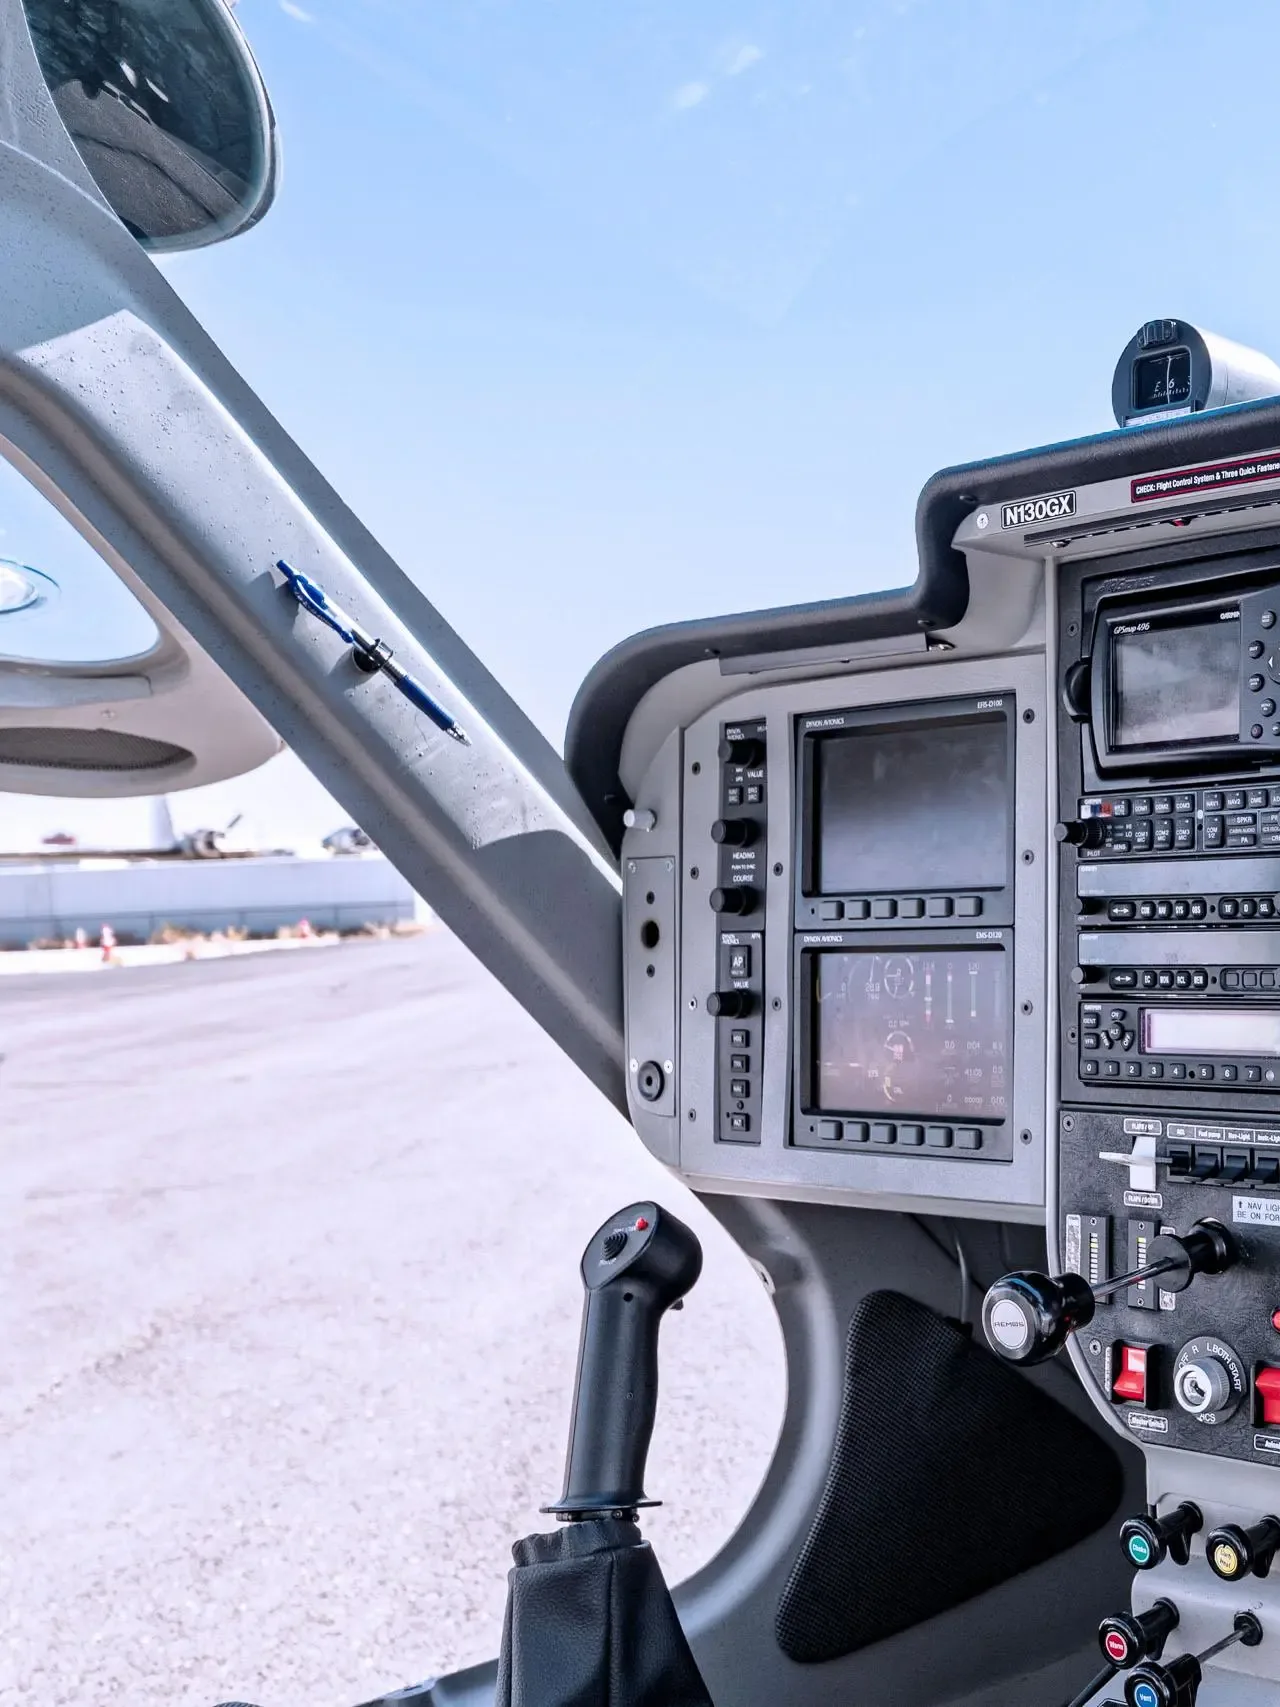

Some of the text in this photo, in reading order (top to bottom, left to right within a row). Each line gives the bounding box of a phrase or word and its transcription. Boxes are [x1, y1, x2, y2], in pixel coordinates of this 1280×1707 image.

[1136, 485, 1156, 494] CHECK:
[1156, 481, 1172, 491] Flight
[1172, 478, 1193, 488] Control
[1193, 474, 1215, 486] System
[1221, 470, 1238, 479] Three
[1239, 466, 1256, 476] Quick
[1004, 494, 1071, 526] N130GX
[1113, 623, 1150, 635] GPSmap 496
[747, 770, 764, 778] VALUE
[733, 852, 755, 860] HEADING
[733, 874, 754, 883] COURSE
[1175, 906, 1183, 914] SYS
[733, 957, 743, 967] AP
[733, 981, 749, 989] VALUE
[1086, 1064, 1092, 1073] 0
[1108, 1064, 1112, 1074] 1
[1129, 1065, 1135, 1074] 2
[1151, 1066, 1157, 1075] 3
[1173, 1067, 1178, 1076] 4
[1202, 1068, 1207, 1077] 5
[1224, 1069, 1230, 1078] 6
[1249, 1070, 1254, 1079] 7
[1247, 1202, 1262, 1210] NAV
[1250, 1212, 1261, 1220] ON
[1265, 1213, 1280, 1221] FOR
[1192, 1345, 1200, 1354] R
[1206, 1342, 1212, 1351] L
[1212, 1344, 1231, 1365] BOTH
[1178, 1353, 1189, 1369] OFF
[1228, 1362, 1242, 1392] START
[1139, 1693, 1152, 1703] Vent
